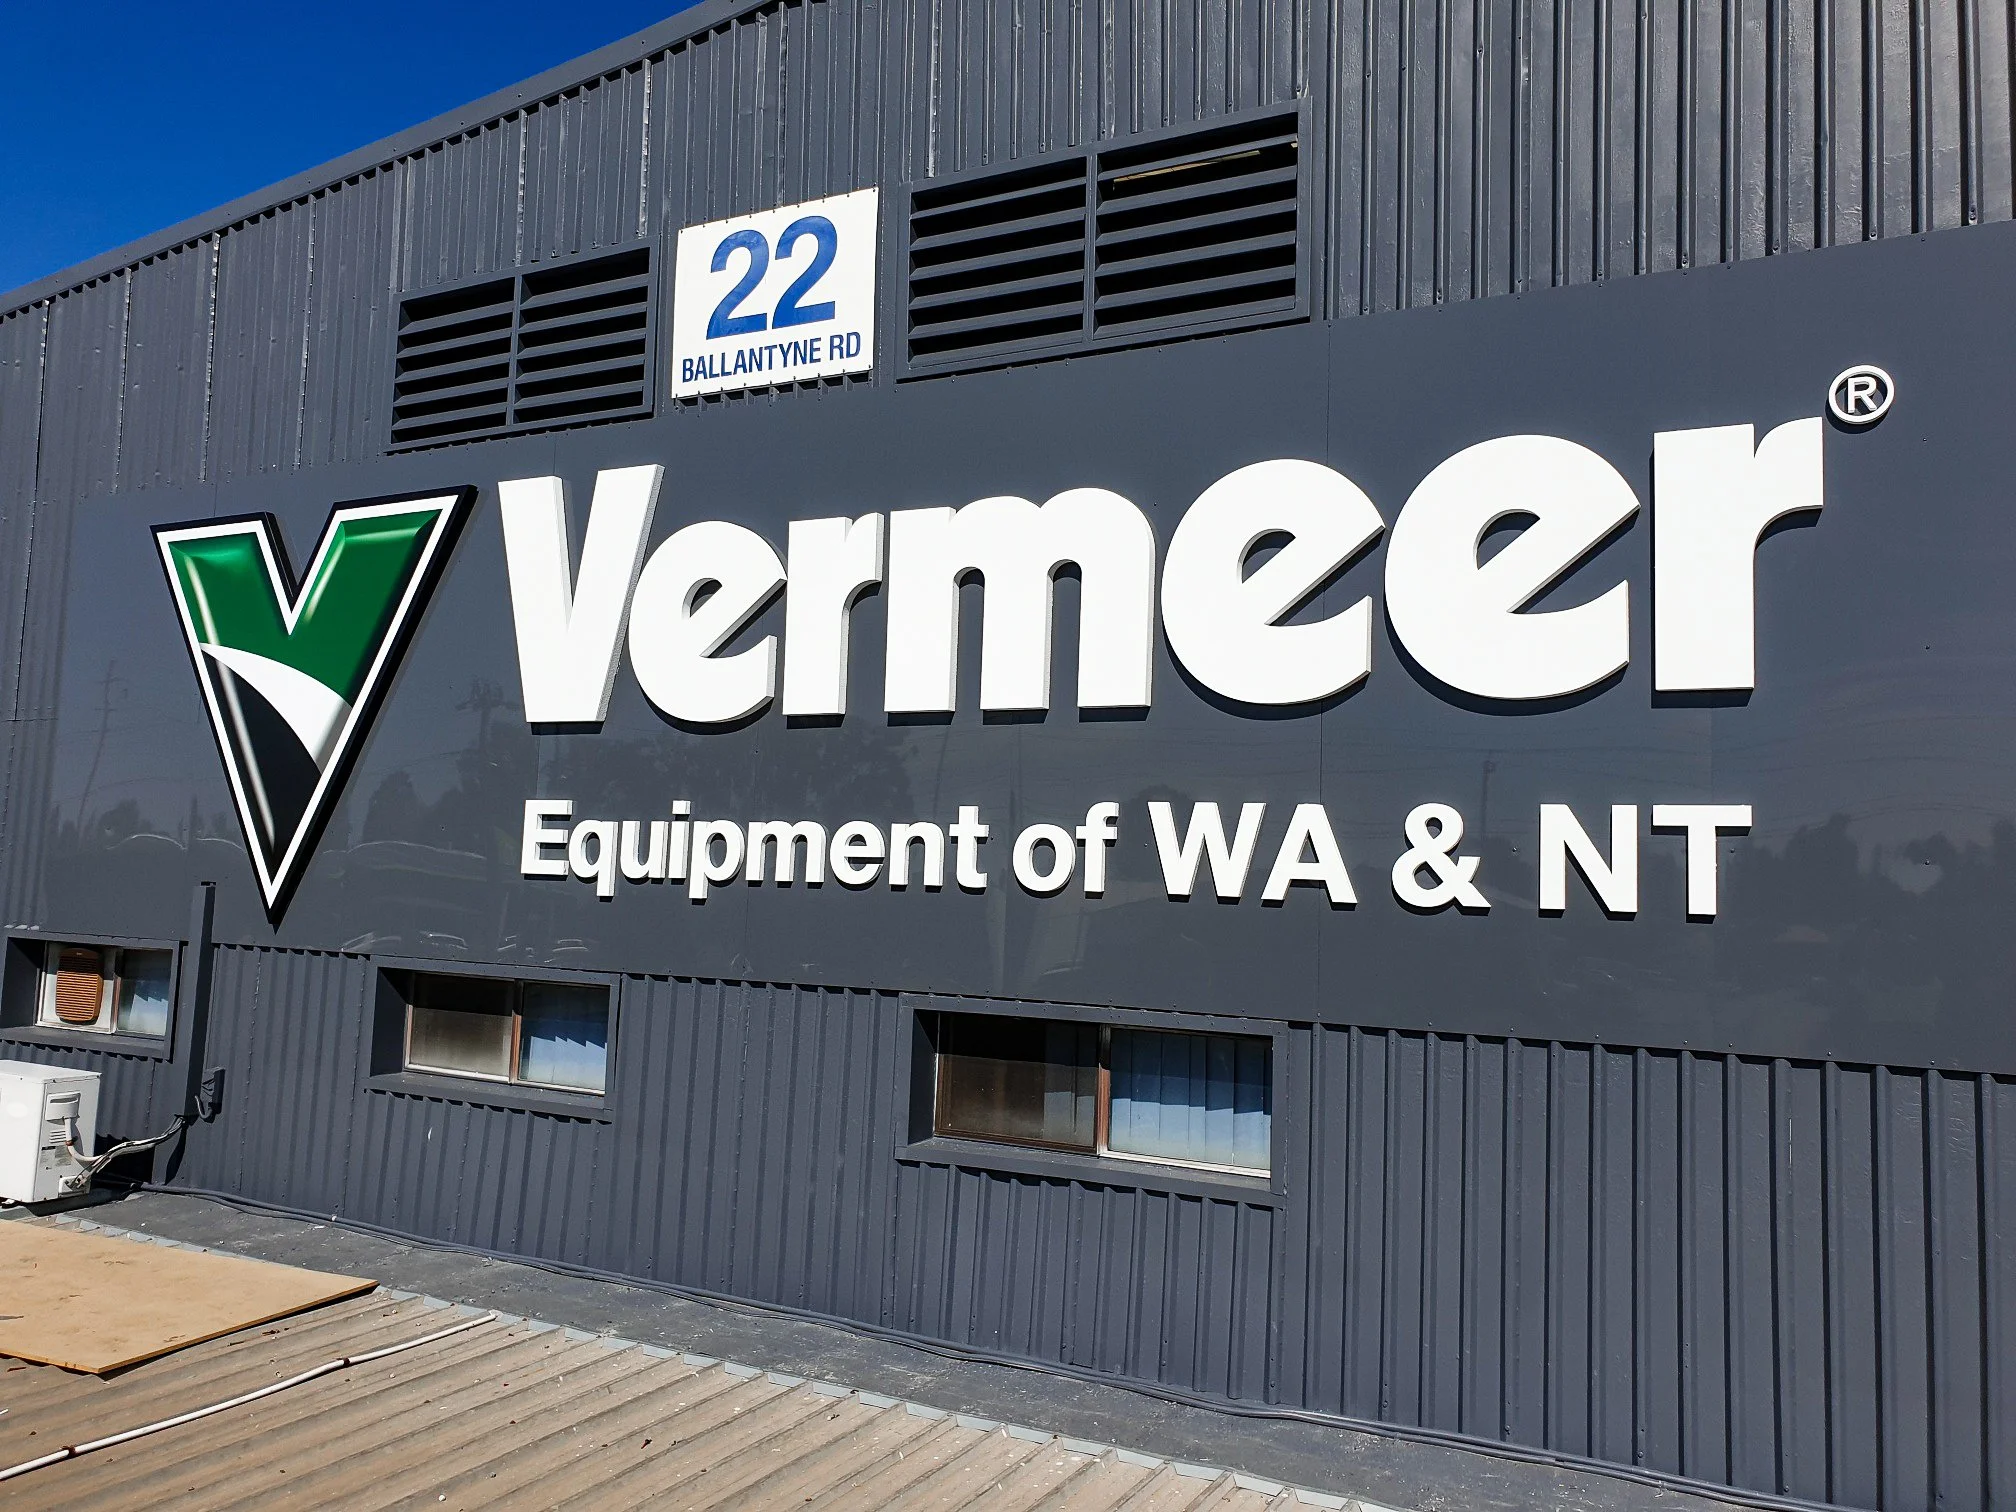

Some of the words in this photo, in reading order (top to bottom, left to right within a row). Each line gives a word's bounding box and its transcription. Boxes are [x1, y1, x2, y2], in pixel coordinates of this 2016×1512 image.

[706, 215, 838, 341] 22
[682, 336, 822, 384] BALLANTYNE
[828, 330, 862, 361] RD
[521, 800, 989, 900] Equipment
[1012, 802, 1120, 893] of
[1148, 801, 1359, 904] WA
[1391, 802, 1492, 908] &
[1539, 803, 1753, 916] NT
